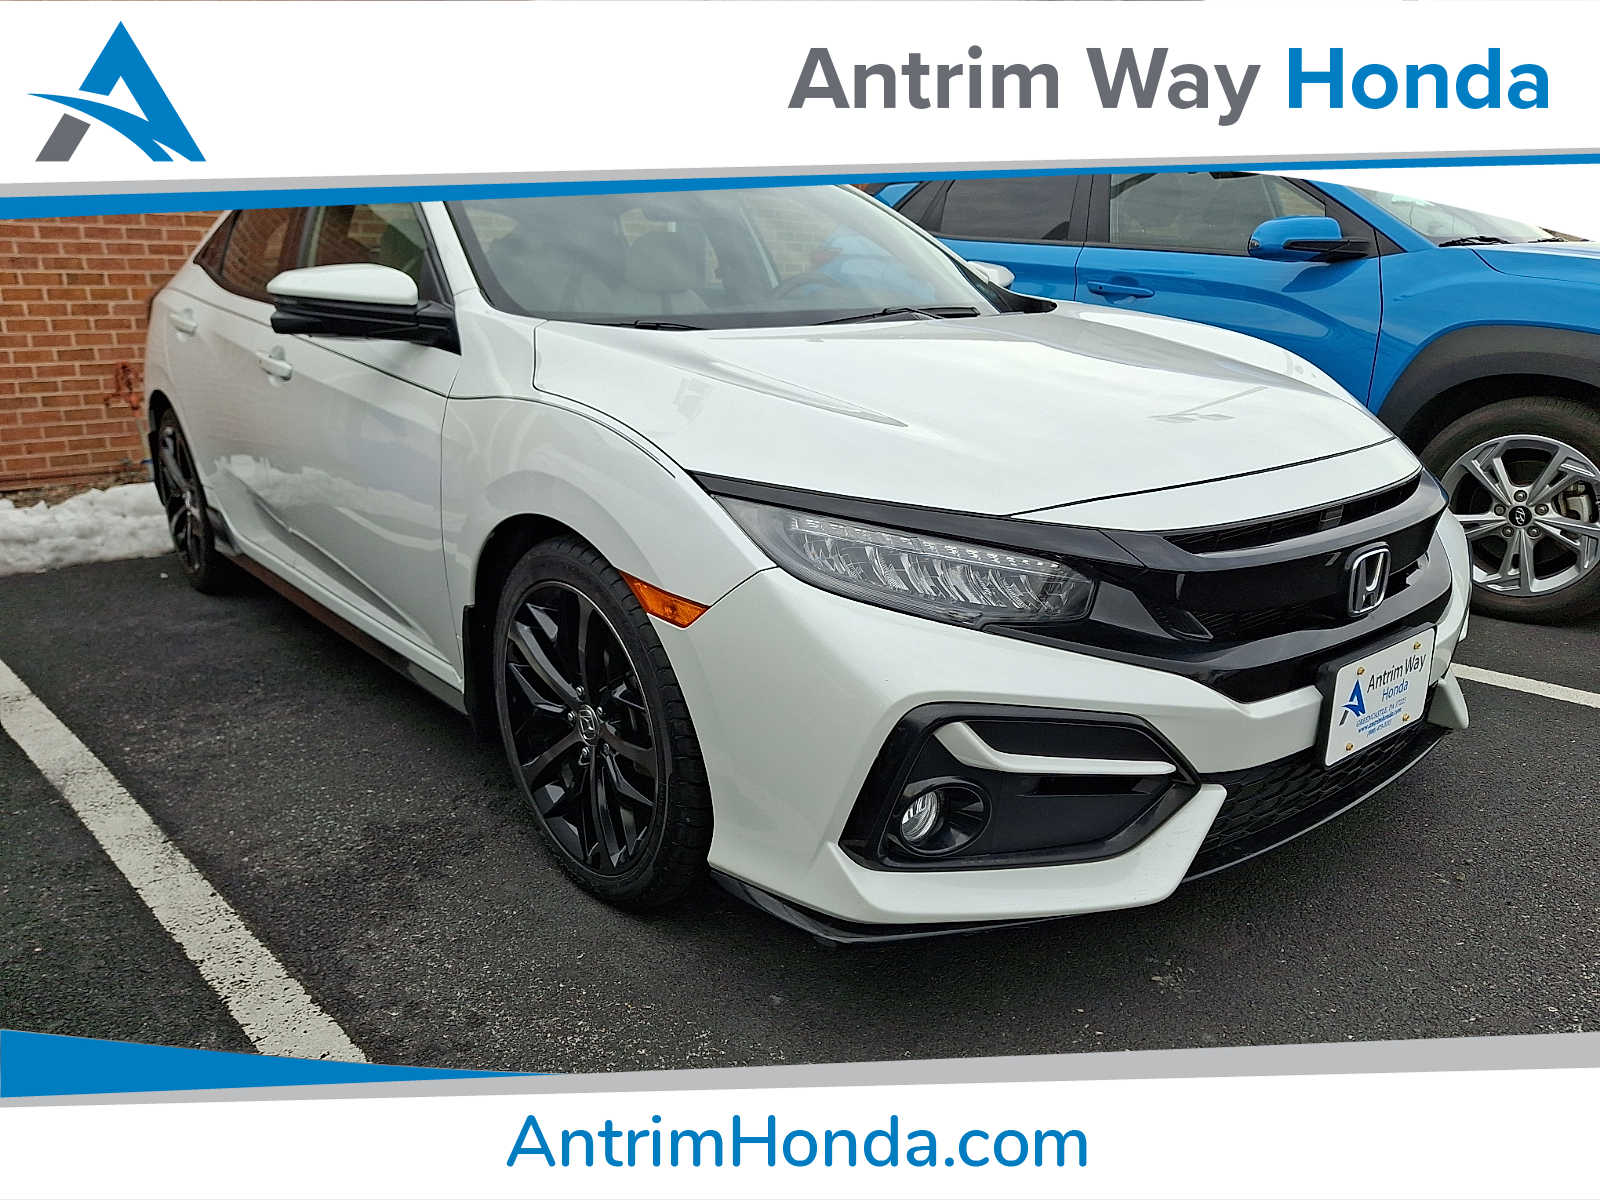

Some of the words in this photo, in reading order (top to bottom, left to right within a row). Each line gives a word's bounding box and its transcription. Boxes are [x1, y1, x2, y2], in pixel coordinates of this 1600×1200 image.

[1367, 665, 1403, 693] Antrim
[1405, 654, 1426, 674] Way
[1382, 679, 1408, 702] Honda
